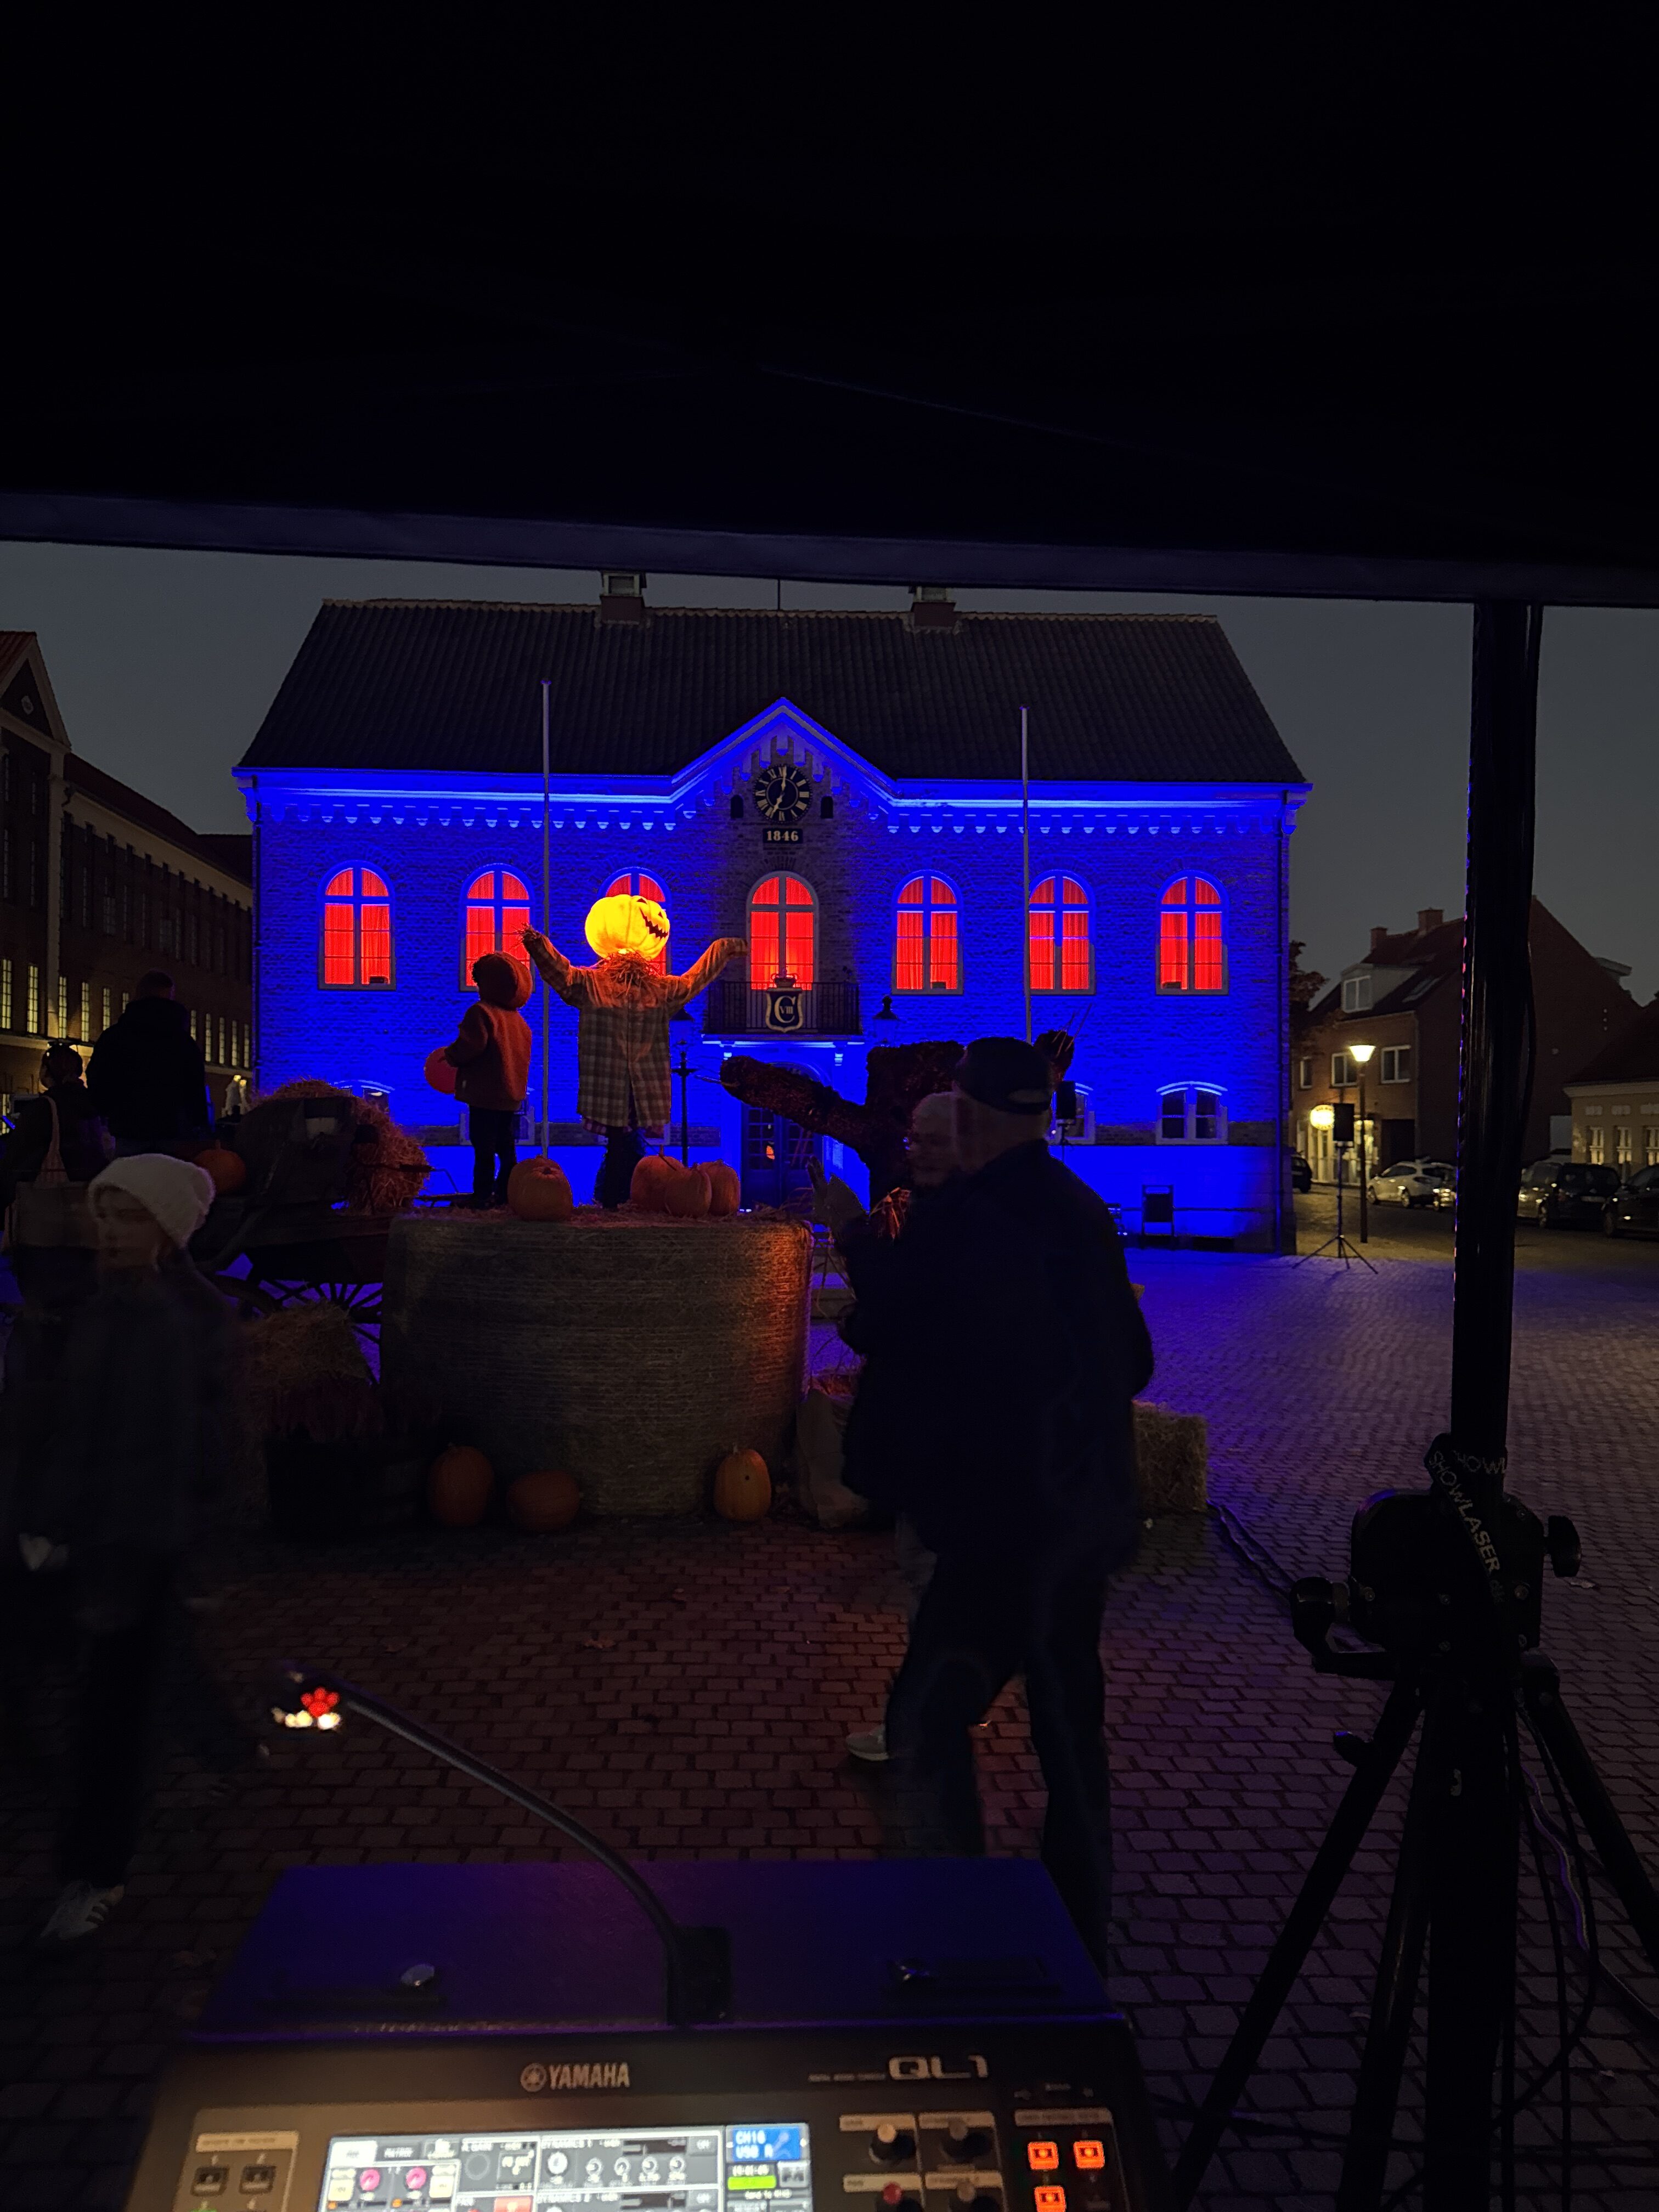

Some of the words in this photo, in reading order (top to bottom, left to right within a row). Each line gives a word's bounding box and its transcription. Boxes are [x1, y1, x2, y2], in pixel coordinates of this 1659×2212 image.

[766, 830, 799, 842] 1846
[774, 996, 796, 1023] C
[1429, 1451, 1500, 1572] SHOWLASER
[549, 2062, 630, 2090] YAMAHA
[889, 2055, 988, 2080] QL1
